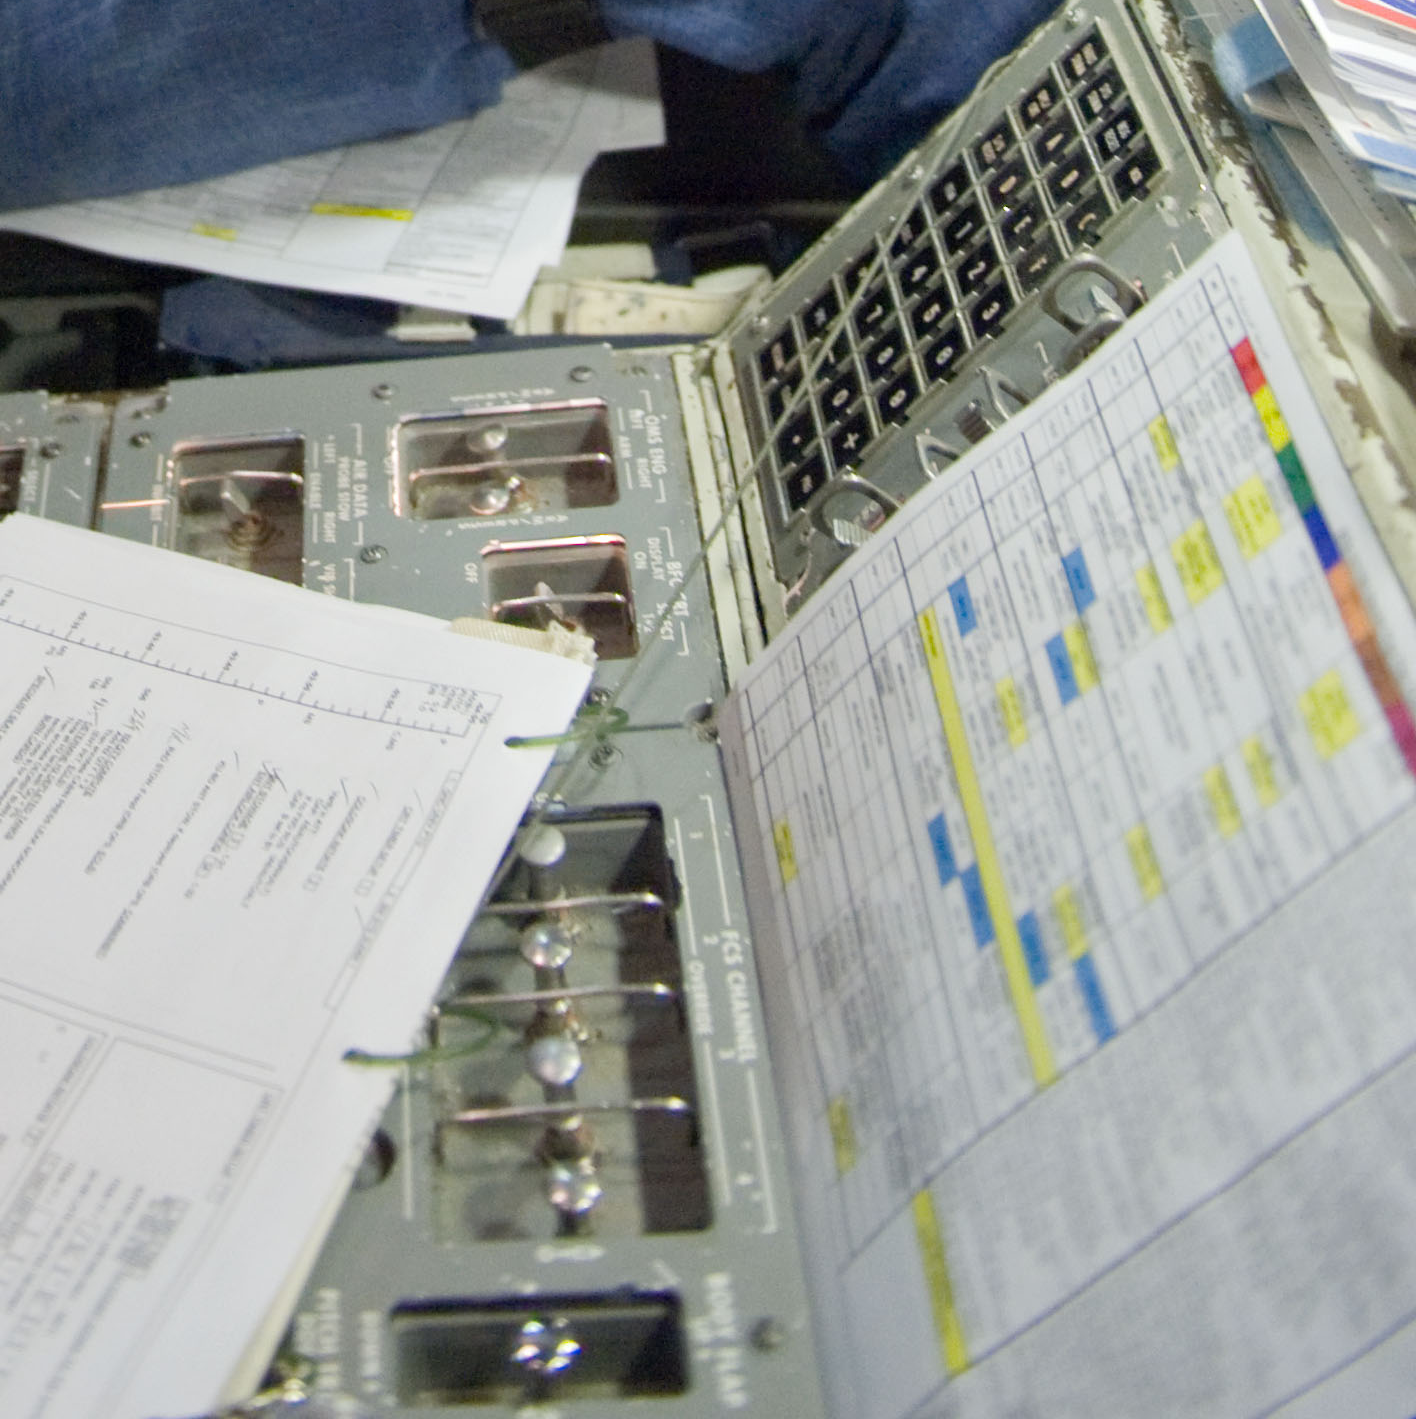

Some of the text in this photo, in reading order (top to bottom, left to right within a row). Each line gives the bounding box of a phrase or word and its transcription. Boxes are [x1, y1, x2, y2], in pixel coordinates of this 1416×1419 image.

[645, 414, 665, 474] OMS ENG
[351, 459, 368, 519] AIR DATA
[635, 458, 652, 489] RIGHT
[463, 563, 476, 583] OFF
[634, 551, 649, 570] ON
[647, 537, 664, 580] DISPLAY
[702, 935, 719, 947] 2
[687, 960, 713, 1036] OVERRIDE
[716, 929, 758, 1063] FCS CHANNEL
